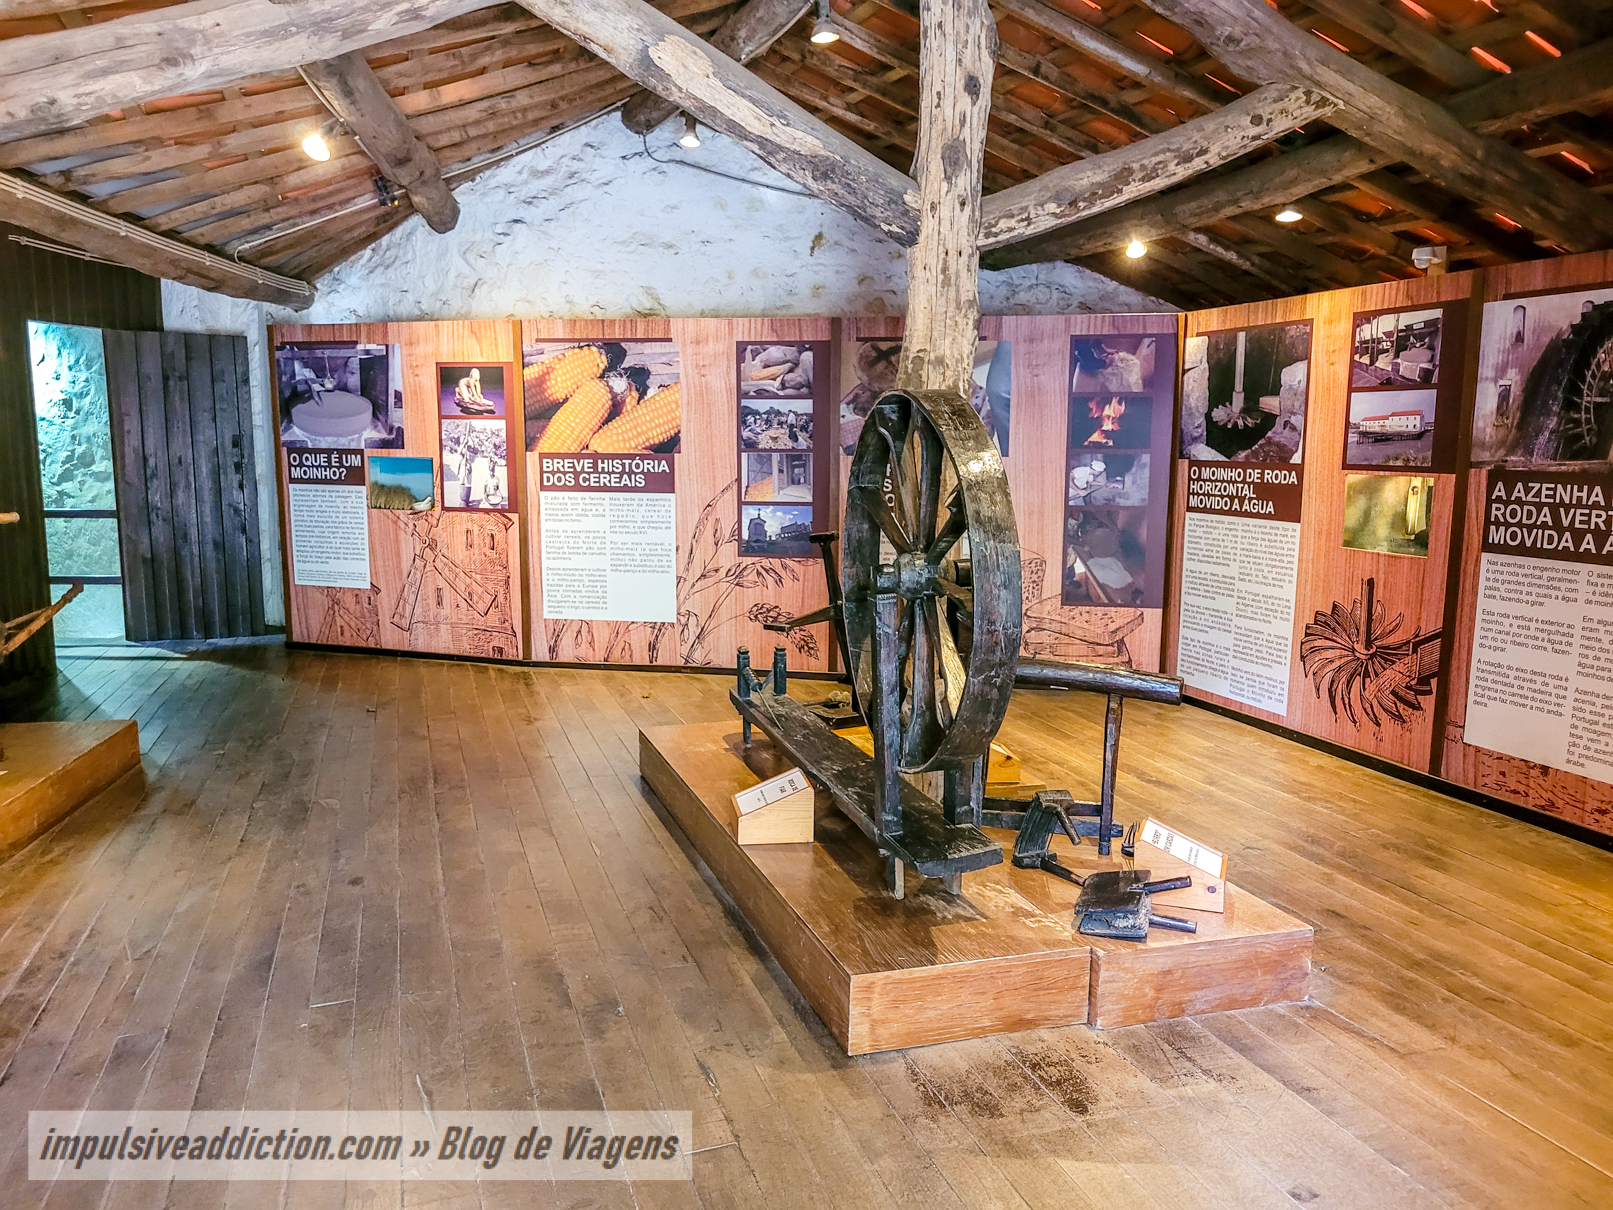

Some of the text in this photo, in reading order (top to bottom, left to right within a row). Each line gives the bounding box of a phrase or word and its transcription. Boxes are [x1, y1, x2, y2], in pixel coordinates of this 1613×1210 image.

[290, 451, 361, 467] O QUE É UM
[542, 456, 670, 473] BREVE HISTÓRIA
[291, 466, 346, 480] MOINHO?
[543, 473, 645, 487] DOS CEREAIS
[1190, 466, 1298, 485] O MOINHO DE RODA
[1190, 481, 1256, 498] HORIZONTAL
[1491, 481, 1606, 506] A AZENHA
[1189, 495, 1275, 514] MOVIDO A ÁGUA
[1490, 503, 1553, 526] RODA
[1488, 525, 1575, 552] MOVIDA
[1578, 533, 1597, 554] A
[1501, 578, 1525, 586] grandes
[1527, 581, 1562, 592] dimensões,
[1521, 572, 1544, 581] vertical,
[1547, 575, 1580, 584] geralmen-
[1587, 579, 1598, 587] fixa
[1484, 592, 1498, 600] bate,
[1499, 594, 1529, 604] fazendo-a
[1561, 594, 1578, 603] água
[1481, 618, 1505, 627] moinho,
[1535, 627, 1574, 638] mergulhada
[1541, 620, 1565, 628] exterior
[1546, 637, 1563, 645] água
[1581, 635, 1604, 644] mente,
[1493, 644, 1507, 652] girar.
[1510, 640, 1529, 648] ribeiro
[1531, 644, 1549, 653] corre,
[1552, 646, 1572, 656] fazen-
[1483, 660, 1504, 669] rotação
[1530, 669, 1546, 678] desta
[1577, 661, 1594, 669] água
[1476, 666, 1509, 678] transmitida
[1513, 675, 1537, 684] através
[1576, 670, 1605, 681] moinhos
[1475, 684, 1498, 693] engrena
[1508, 692, 1529, 700] carrete
[1490, 678, 1514, 688] dentada
[1527, 687, 1552, 697] madeira
[1574, 687, 1600, 699] Azenha
[1473, 699, 1489, 708] deira.
[1509, 700, 1528, 708] mover
[1546, 708, 1565, 717] anda-
[1572, 705, 1606, 718] sido esse
[1571, 713, 1600, 726] Portugal
[1569, 731, 1584, 740] tese
[1566, 757, 1587, 769] árabe.
